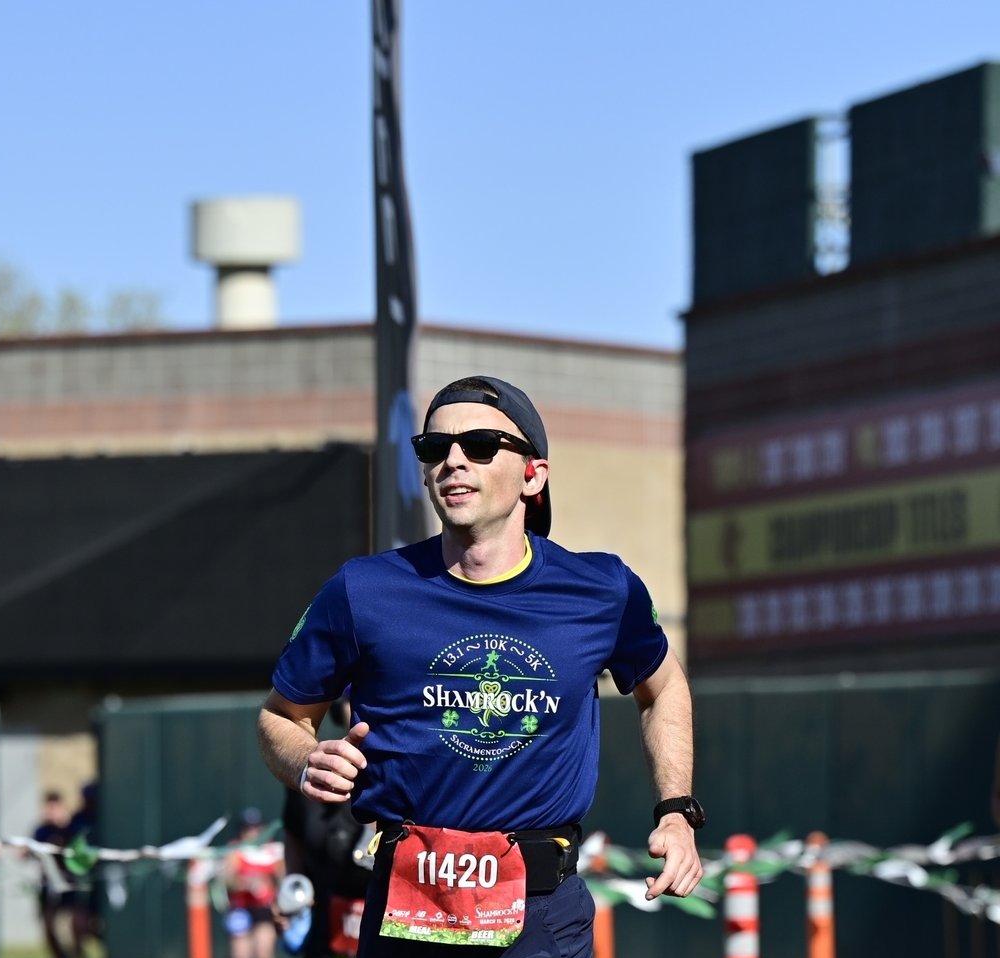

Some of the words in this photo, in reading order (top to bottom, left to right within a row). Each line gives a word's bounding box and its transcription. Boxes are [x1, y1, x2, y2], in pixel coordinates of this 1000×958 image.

[443, 648, 464, 667] 13.1
[485, 639, 507, 651] 10K
[525, 655, 542, 671] 5K
[422, 684, 560, 713] SHAMROCK'N
[417, 851, 498, 888] 11420
[471, 930, 495, 940] BEER
